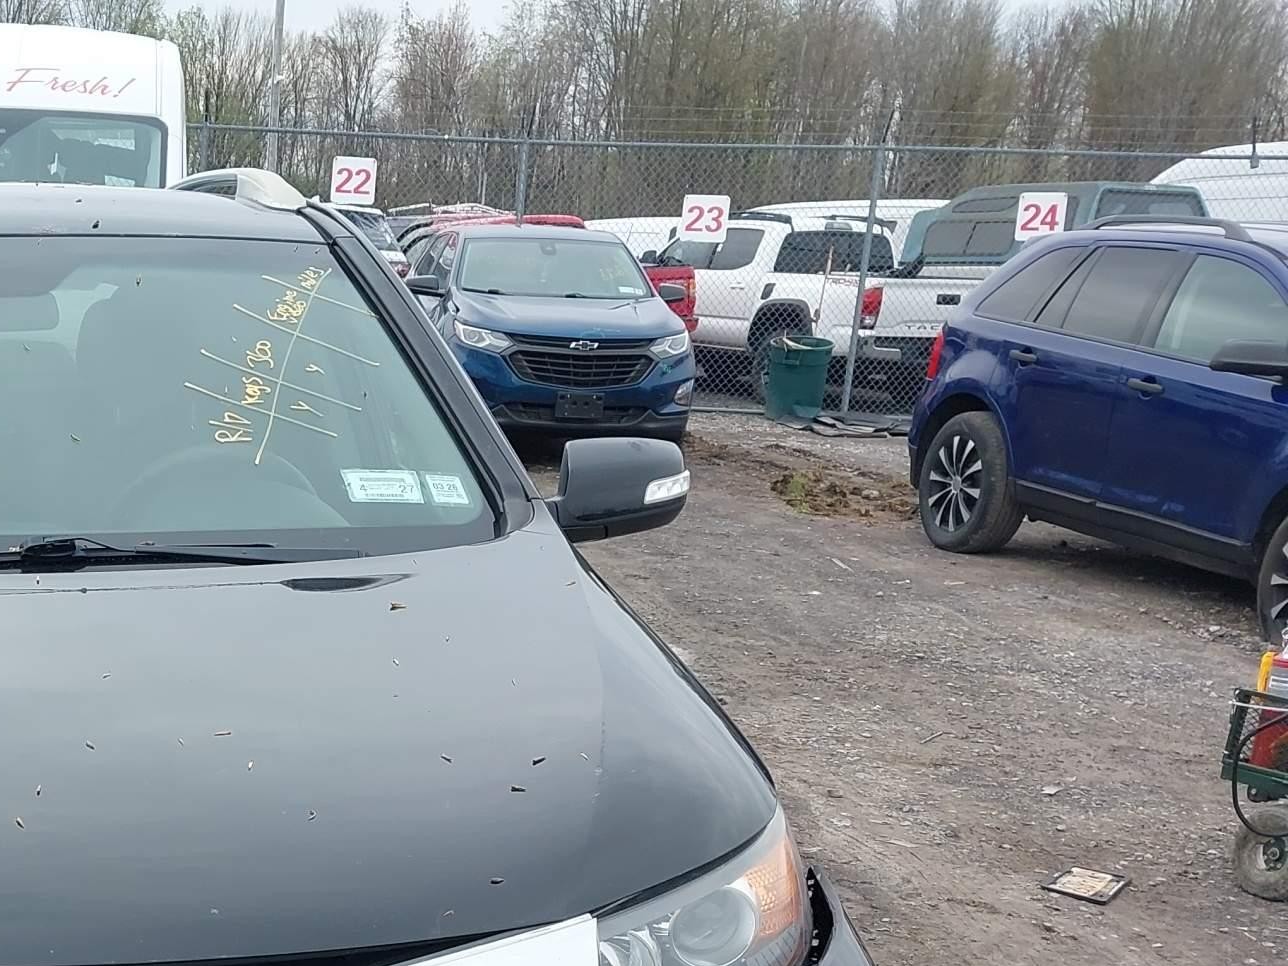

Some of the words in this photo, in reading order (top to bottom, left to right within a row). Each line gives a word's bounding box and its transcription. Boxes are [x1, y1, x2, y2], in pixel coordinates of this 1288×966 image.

[6, 67, 136, 98] Fresh!
[334, 167, 371, 195] 22
[684, 205, 724, 233] 23
[1020, 203, 1059, 232] 24
[398, 484, 414, 494] 27
